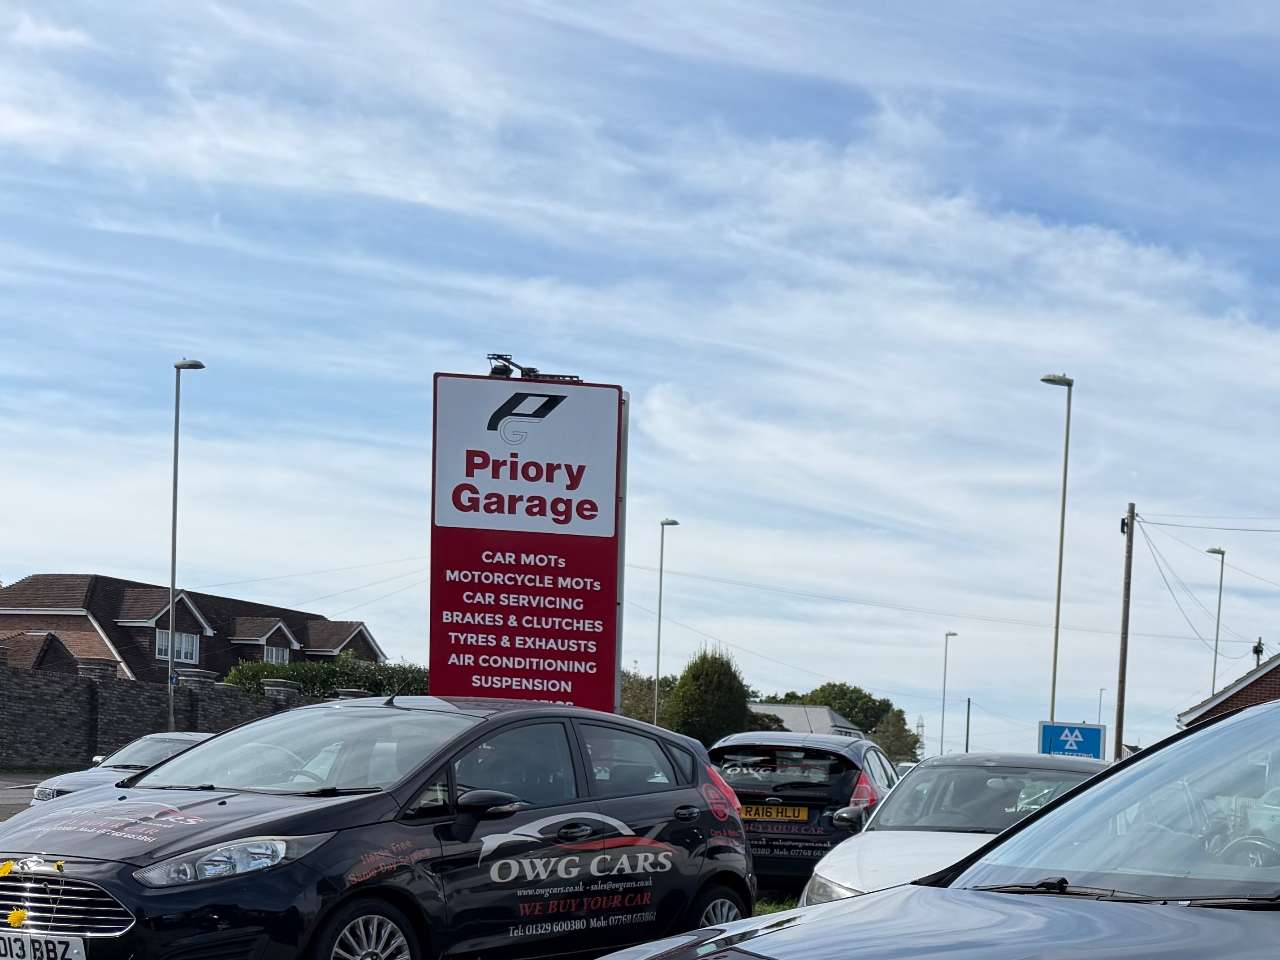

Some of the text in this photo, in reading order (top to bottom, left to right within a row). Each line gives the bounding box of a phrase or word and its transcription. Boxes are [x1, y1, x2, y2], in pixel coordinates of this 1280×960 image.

[465, 449, 587, 491] Priory
[452, 483, 599, 525] Garage
[481, 550, 567, 568] CAR MOTs
[445, 569, 601, 592] MOTORCYCLE MOTs
[462, 591, 584, 611] CAR SERVICING
[442, 610, 604, 633] BRAKES & CLUTCHES
[447, 631, 598, 653] TYRES & EXHAUSTS
[447, 653, 598, 674] AIR CONDITIONING
[471, 675, 573, 693] SUSPENSION
[744, 806, 801, 819] RA16 HLU
[490, 851, 673, 883] OWG CARS
[519, 891, 653, 917] WE BUY YOUR CAR
[526, 923, 551, 936] 01329
[553, 920, 587, 933] 600380
